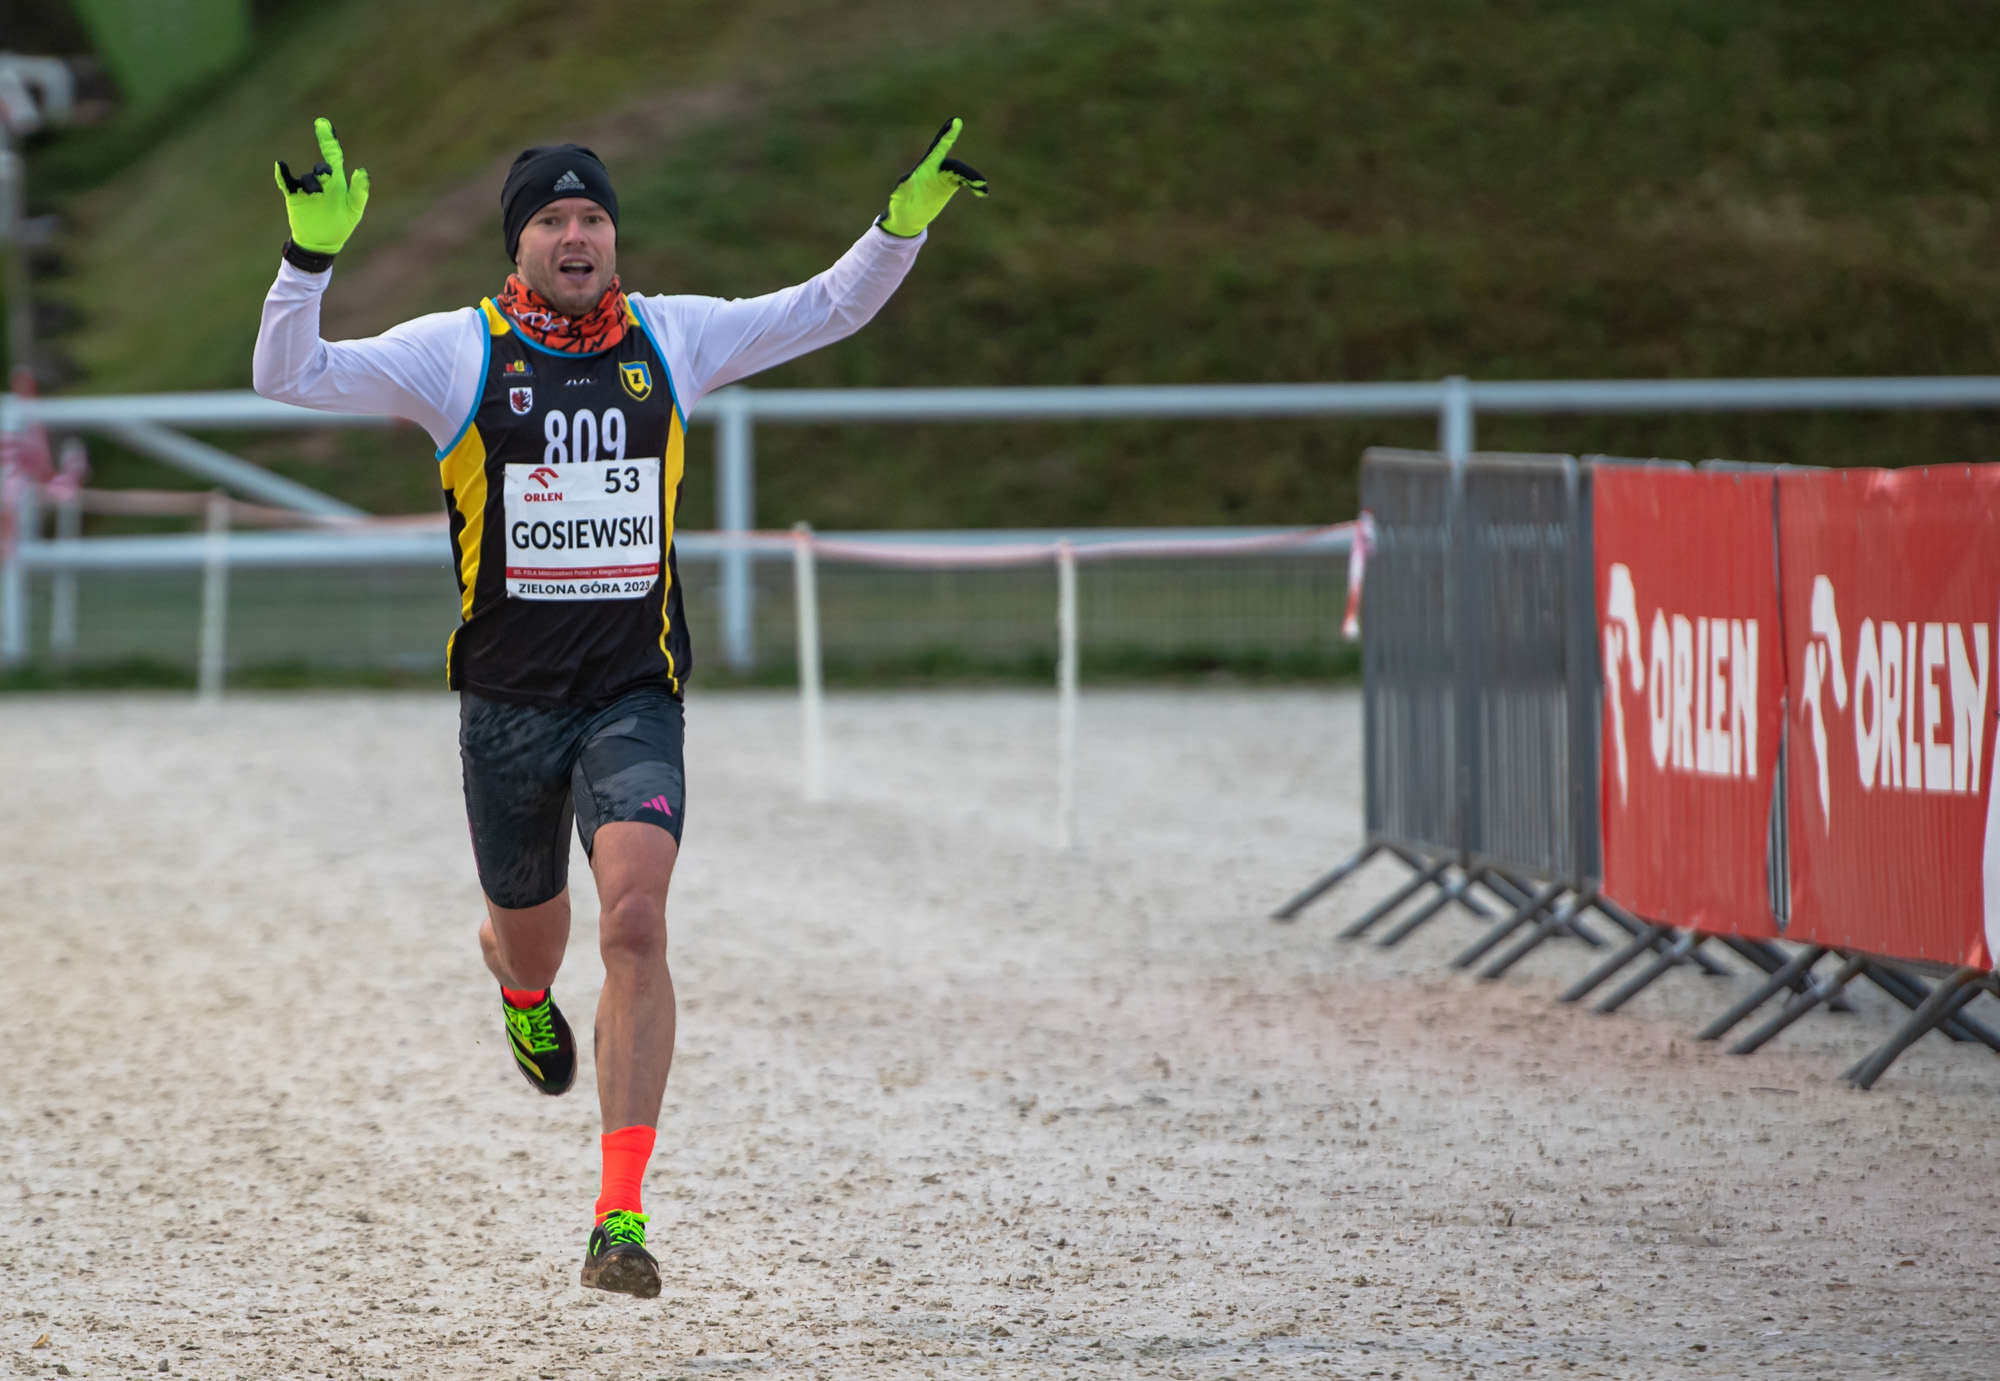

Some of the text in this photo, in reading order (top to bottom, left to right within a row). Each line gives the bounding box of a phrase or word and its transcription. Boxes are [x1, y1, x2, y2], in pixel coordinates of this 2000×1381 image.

[554, 181, 585, 191] adidas
[544, 407, 626, 464] 809
[604, 466, 641, 494] 53
[523, 492, 563, 503] ORLEN
[511, 515, 654, 550] GOSIEWSKI
[518, 579, 651, 595] ZIELONA GÓRA 2023
[1650, 607, 1758, 779] ORLEN
[1854, 616, 1989, 794] ORLEN
